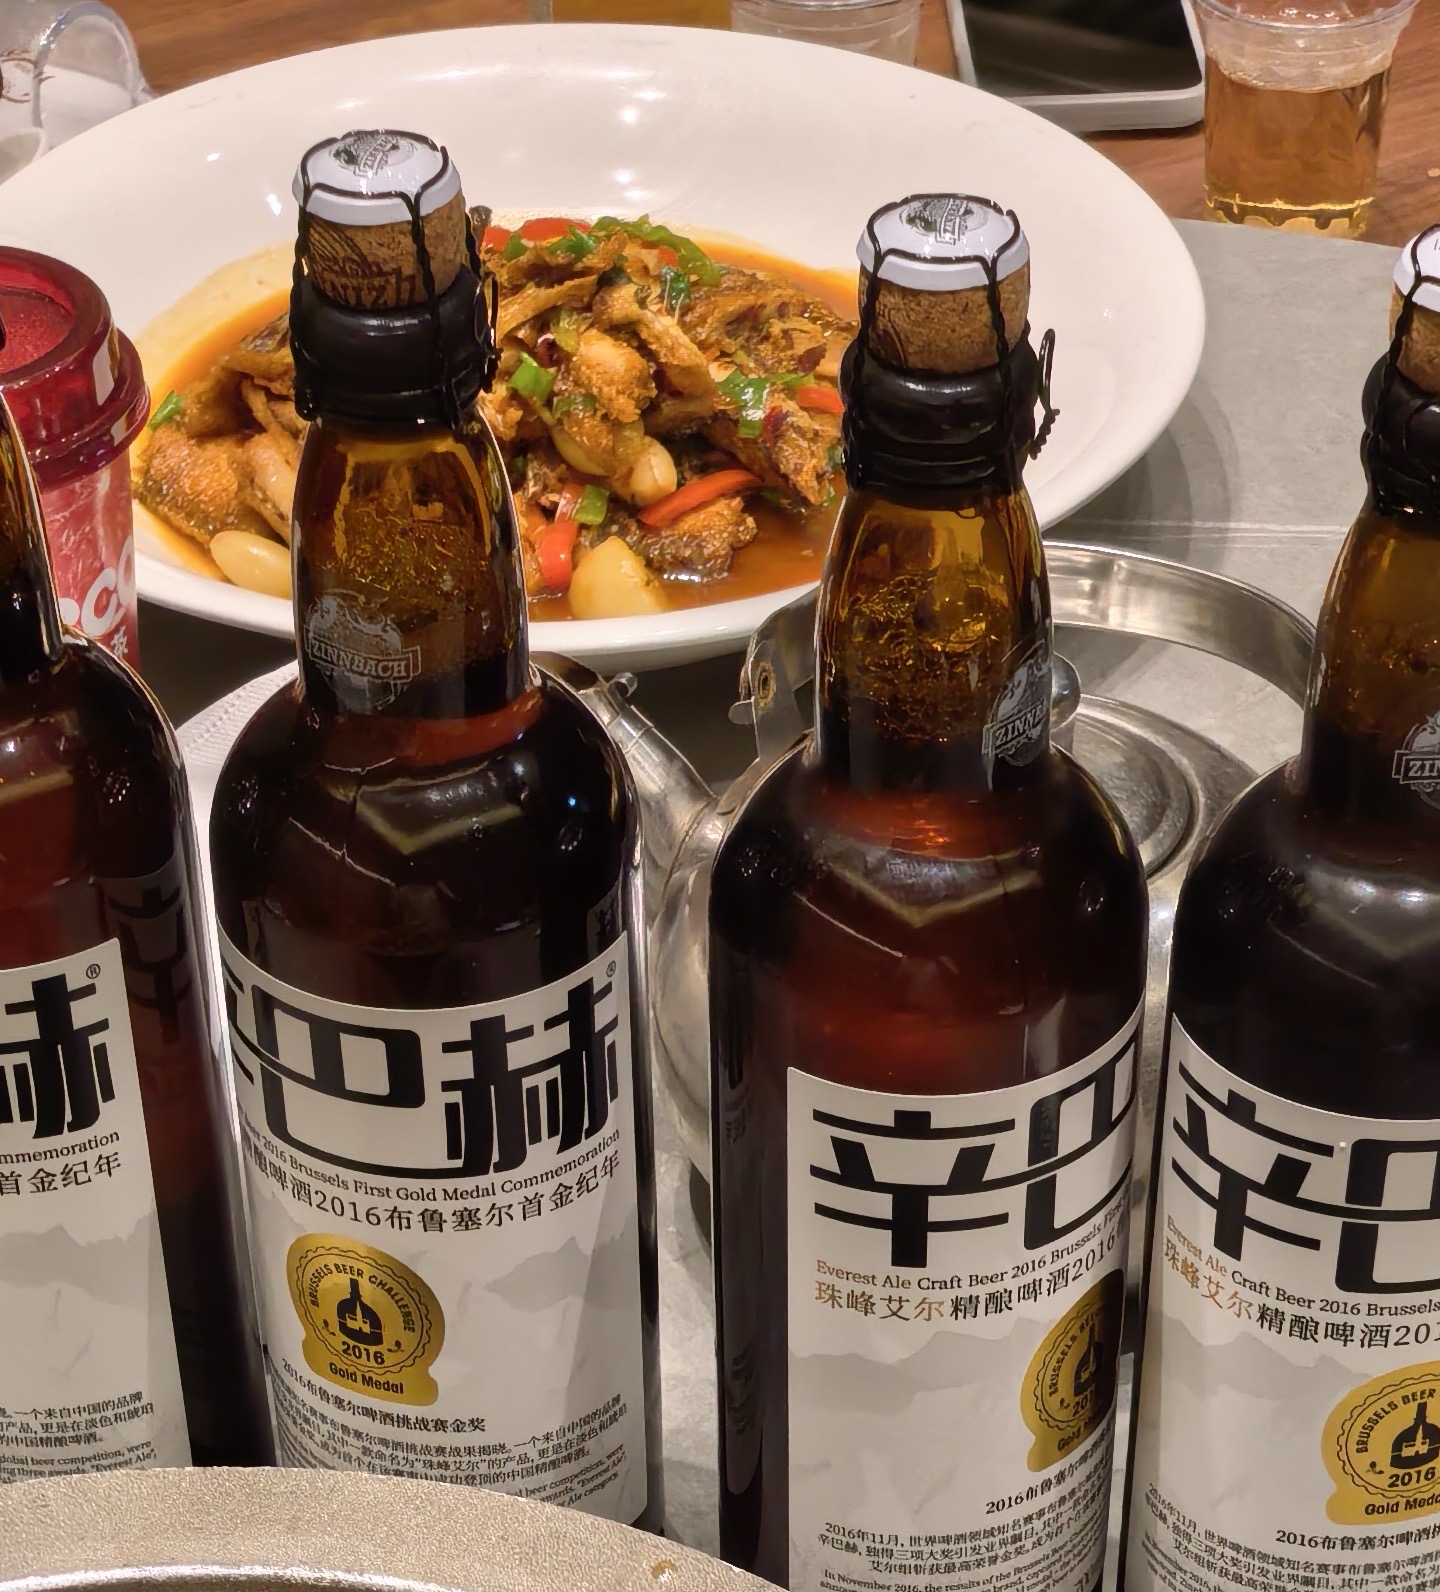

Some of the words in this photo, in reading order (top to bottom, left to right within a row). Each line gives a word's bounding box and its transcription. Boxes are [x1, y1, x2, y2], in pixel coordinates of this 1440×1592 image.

[311, 640, 407, 678] ZINNBACH
[261, 1136, 287, 1161] 2016
[289, 1154, 350, 1190] Brussels
[353, 1179, 393, 1199] First
[396, 1187, 437, 1202] Gold
[443, 1182, 496, 1202] Medal
[501, 1128, 620, 1194] Commemoration
[814, 1212, 1128, 1322] 珠峰艾尔精酿啤酒2016
[816, 1259, 878, 1288] Everest
[881, 1274, 912, 1289] Ale
[917, 1274, 963, 1291] Craft
[968, 1271, 1009, 1288] Beer
[1011, 1254, 1047, 1279] 2016
[1050, 1222, 1102, 1266] Brussels
[1166, 1214, 1202, 1262] Everest
[1205, 1254, 1228, 1277] Ale
[1231, 1270, 1271, 1298] Craft
[1275, 1286, 1316, 1310] Beer
[1319, 1299, 1360, 1316] 2016
[308, 1263, 334, 1308] BRUSSELS
[334, 1263, 365, 1279] BEER
[368, 1274, 416, 1334] CHALLENGE
[341, 1340, 386, 1366] 2016
[329, 1361, 358, 1384] Gold
[361, 1372, 404, 1395] Medal
[1057, 1425, 1082, 1452] Gold
[1355, 1400, 1399, 1454] BRUSSELS
[1401, 1388, 1437, 1405] BEER
[1387, 1466, 1437, 1489] 2016
[1364, 1501, 1400, 1516] Gold
[838, 1571, 892, 1592] November
[924, 1583, 942, 1592] the
